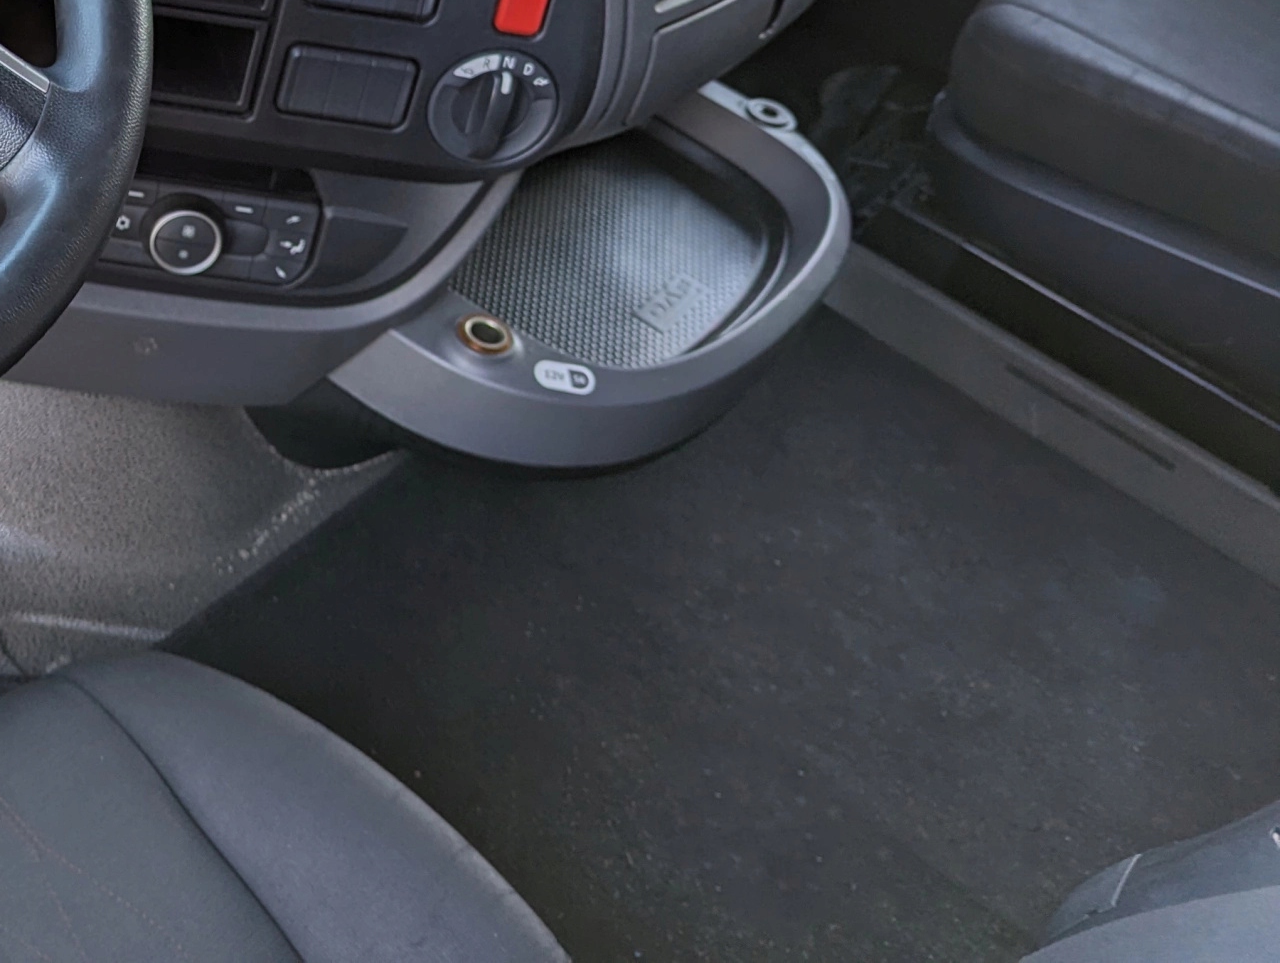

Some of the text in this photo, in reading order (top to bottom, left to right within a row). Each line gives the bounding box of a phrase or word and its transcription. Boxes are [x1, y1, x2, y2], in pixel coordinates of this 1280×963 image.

[482, 58, 491, 69] R
[502, 55, 516, 70] N
[522, 62, 535, 76] D
